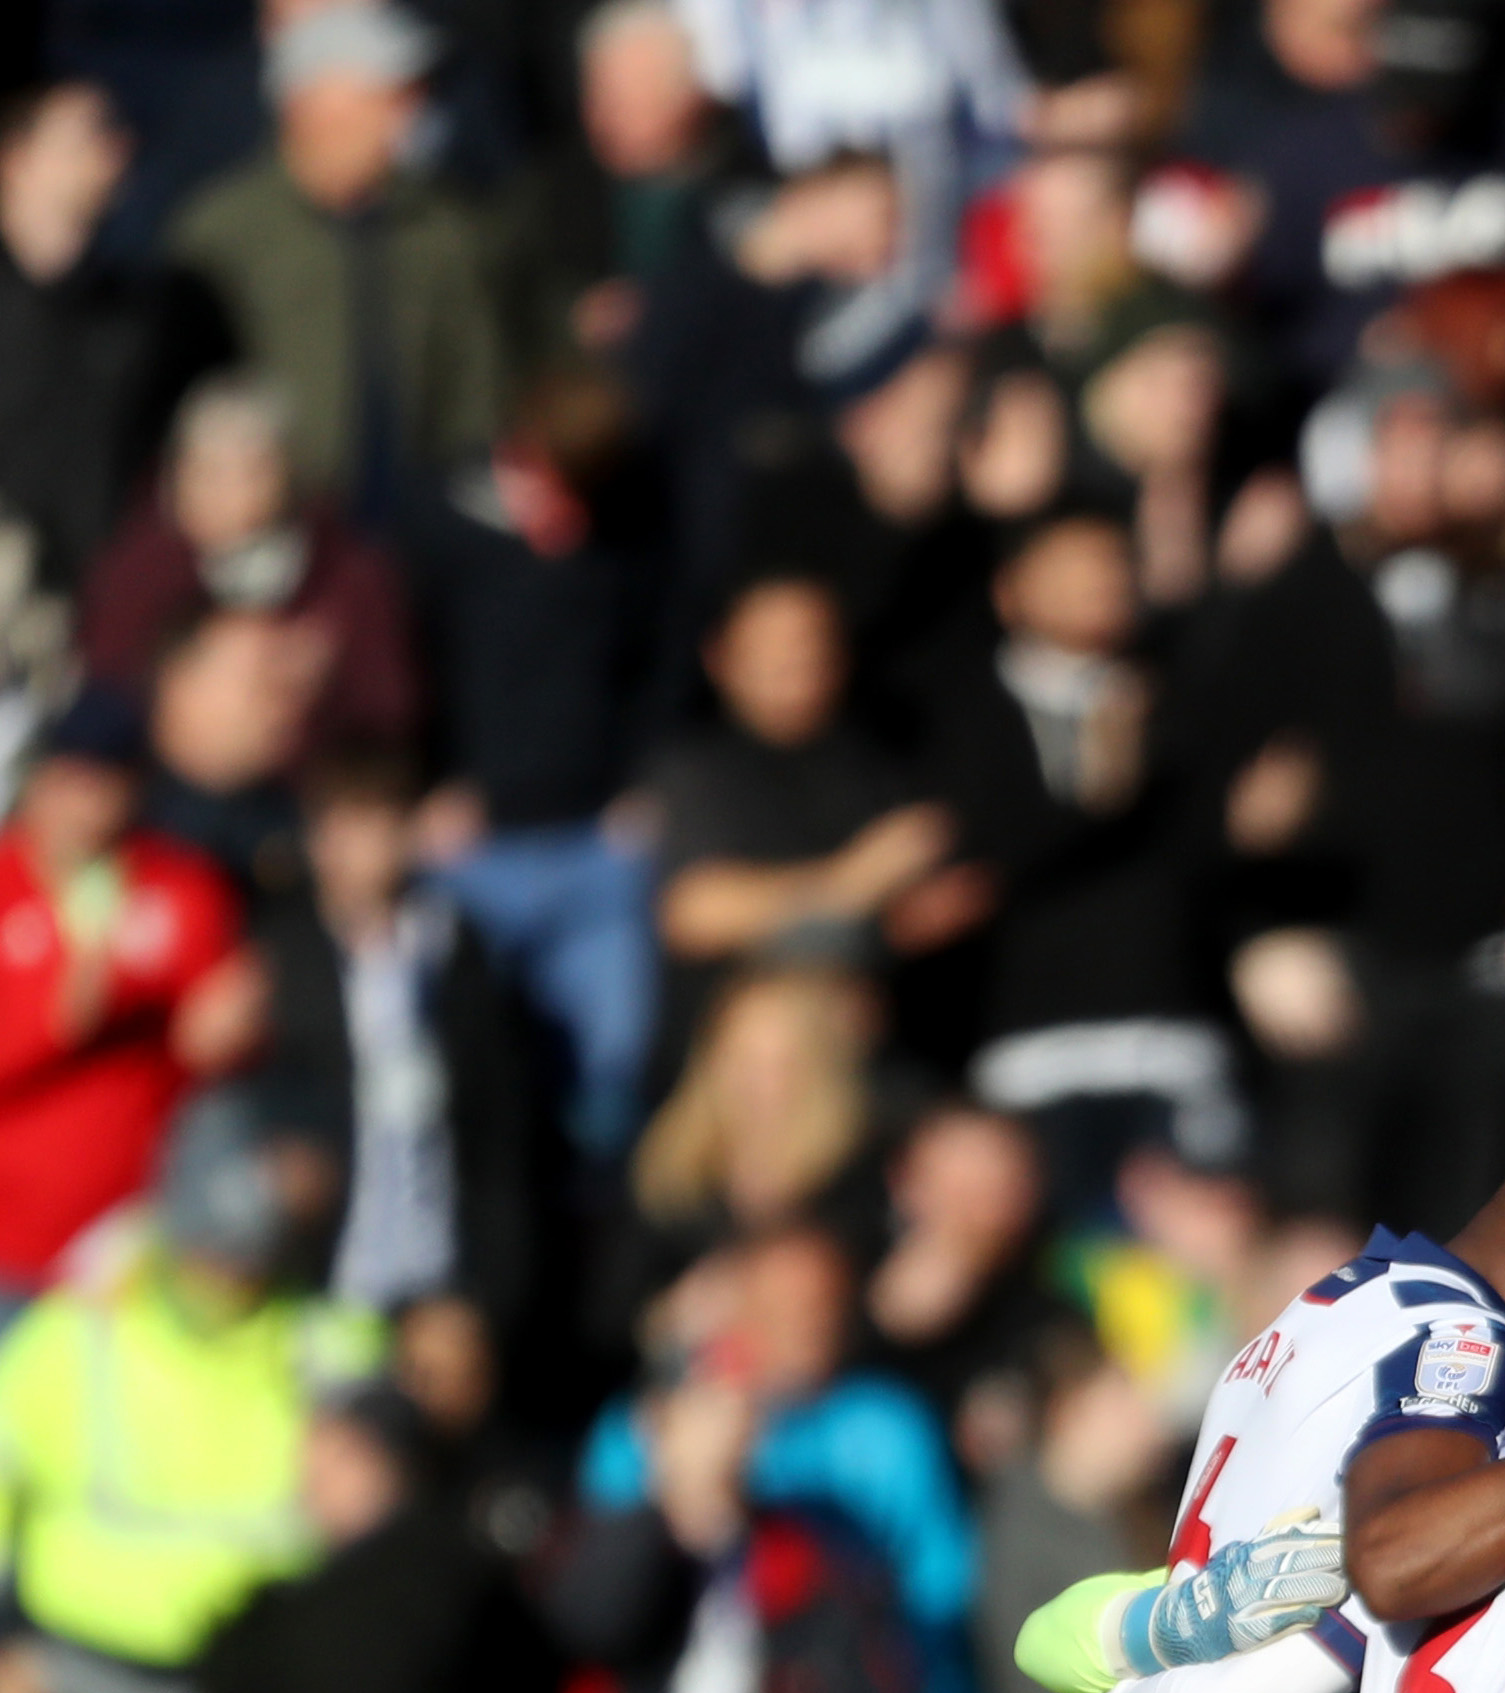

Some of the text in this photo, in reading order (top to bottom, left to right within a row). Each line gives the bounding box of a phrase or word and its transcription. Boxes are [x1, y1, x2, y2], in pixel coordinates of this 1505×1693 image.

[1428, 1341, 1488, 1354] sky bet
[1436, 1381, 1459, 1390] EFL
